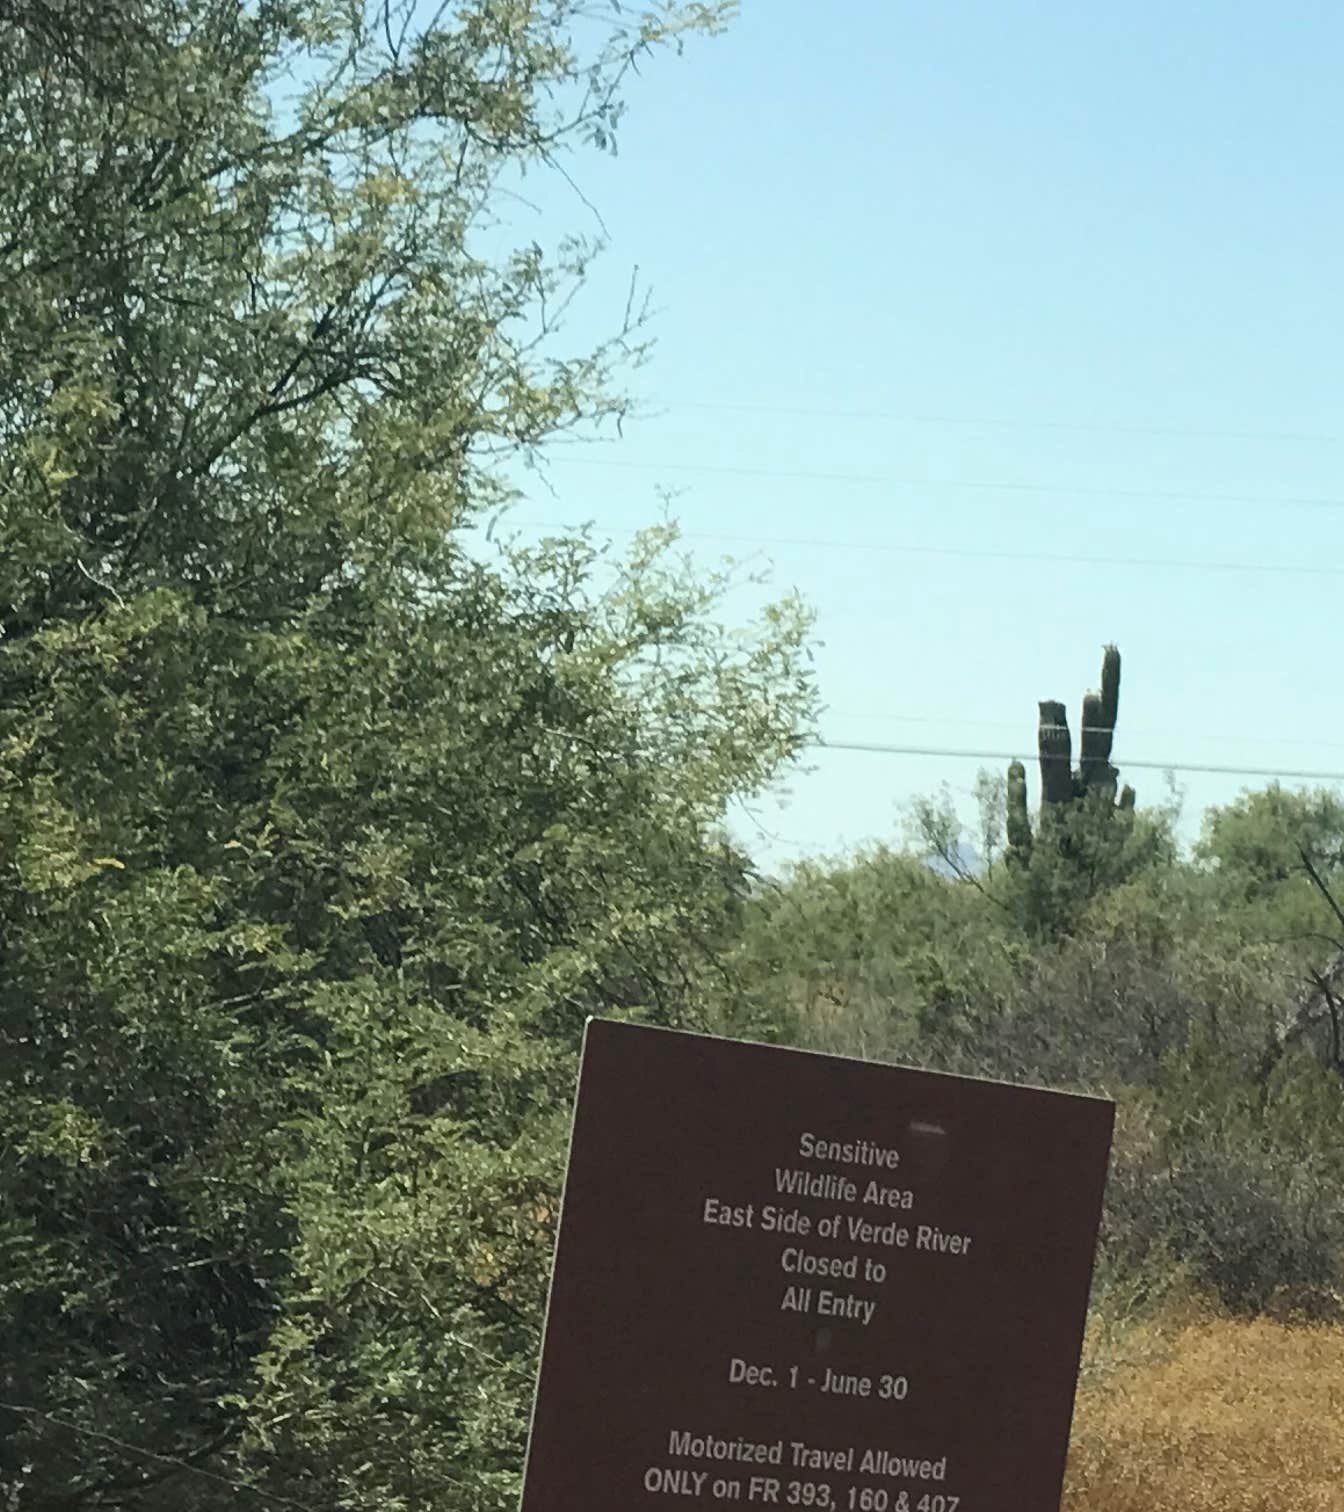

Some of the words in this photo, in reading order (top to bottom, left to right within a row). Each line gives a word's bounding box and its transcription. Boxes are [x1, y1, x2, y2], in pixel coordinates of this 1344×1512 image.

[799, 1132, 900, 1169] Sensitive
[775, 1167, 857, 1203] Wildlife
[862, 1180, 914, 1209] Area
[703, 1197, 755, 1229] East
[760, 1205, 812, 1236] Side
[817, 1214, 843, 1239] of
[847, 1215, 910, 1247] Verde
[915, 1225, 972, 1255] River
[781, 1247, 859, 1279] Closed
[864, 1257, 887, 1283] to
[780, 1286, 812, 1313] All
[817, 1290, 876, 1326] Entry
[729, 1357, 779, 1387] Dec.
[789, 1365, 799, 1389] 1
[820, 1367, 873, 1397] June
[877, 1374, 908, 1401] 30
[668, 1430, 783, 1465] Motorized
[790, 1441, 855, 1472] Travel
[859, 1449, 947, 1481] Allowed
[644, 1467, 709, 1497] ONLY
[712, 1479, 741, 1500] on
[748, 1476, 781, 1503] FR
[786, 1481, 837, 1512] 393,
[848, 1485, 889, 1512] 160
